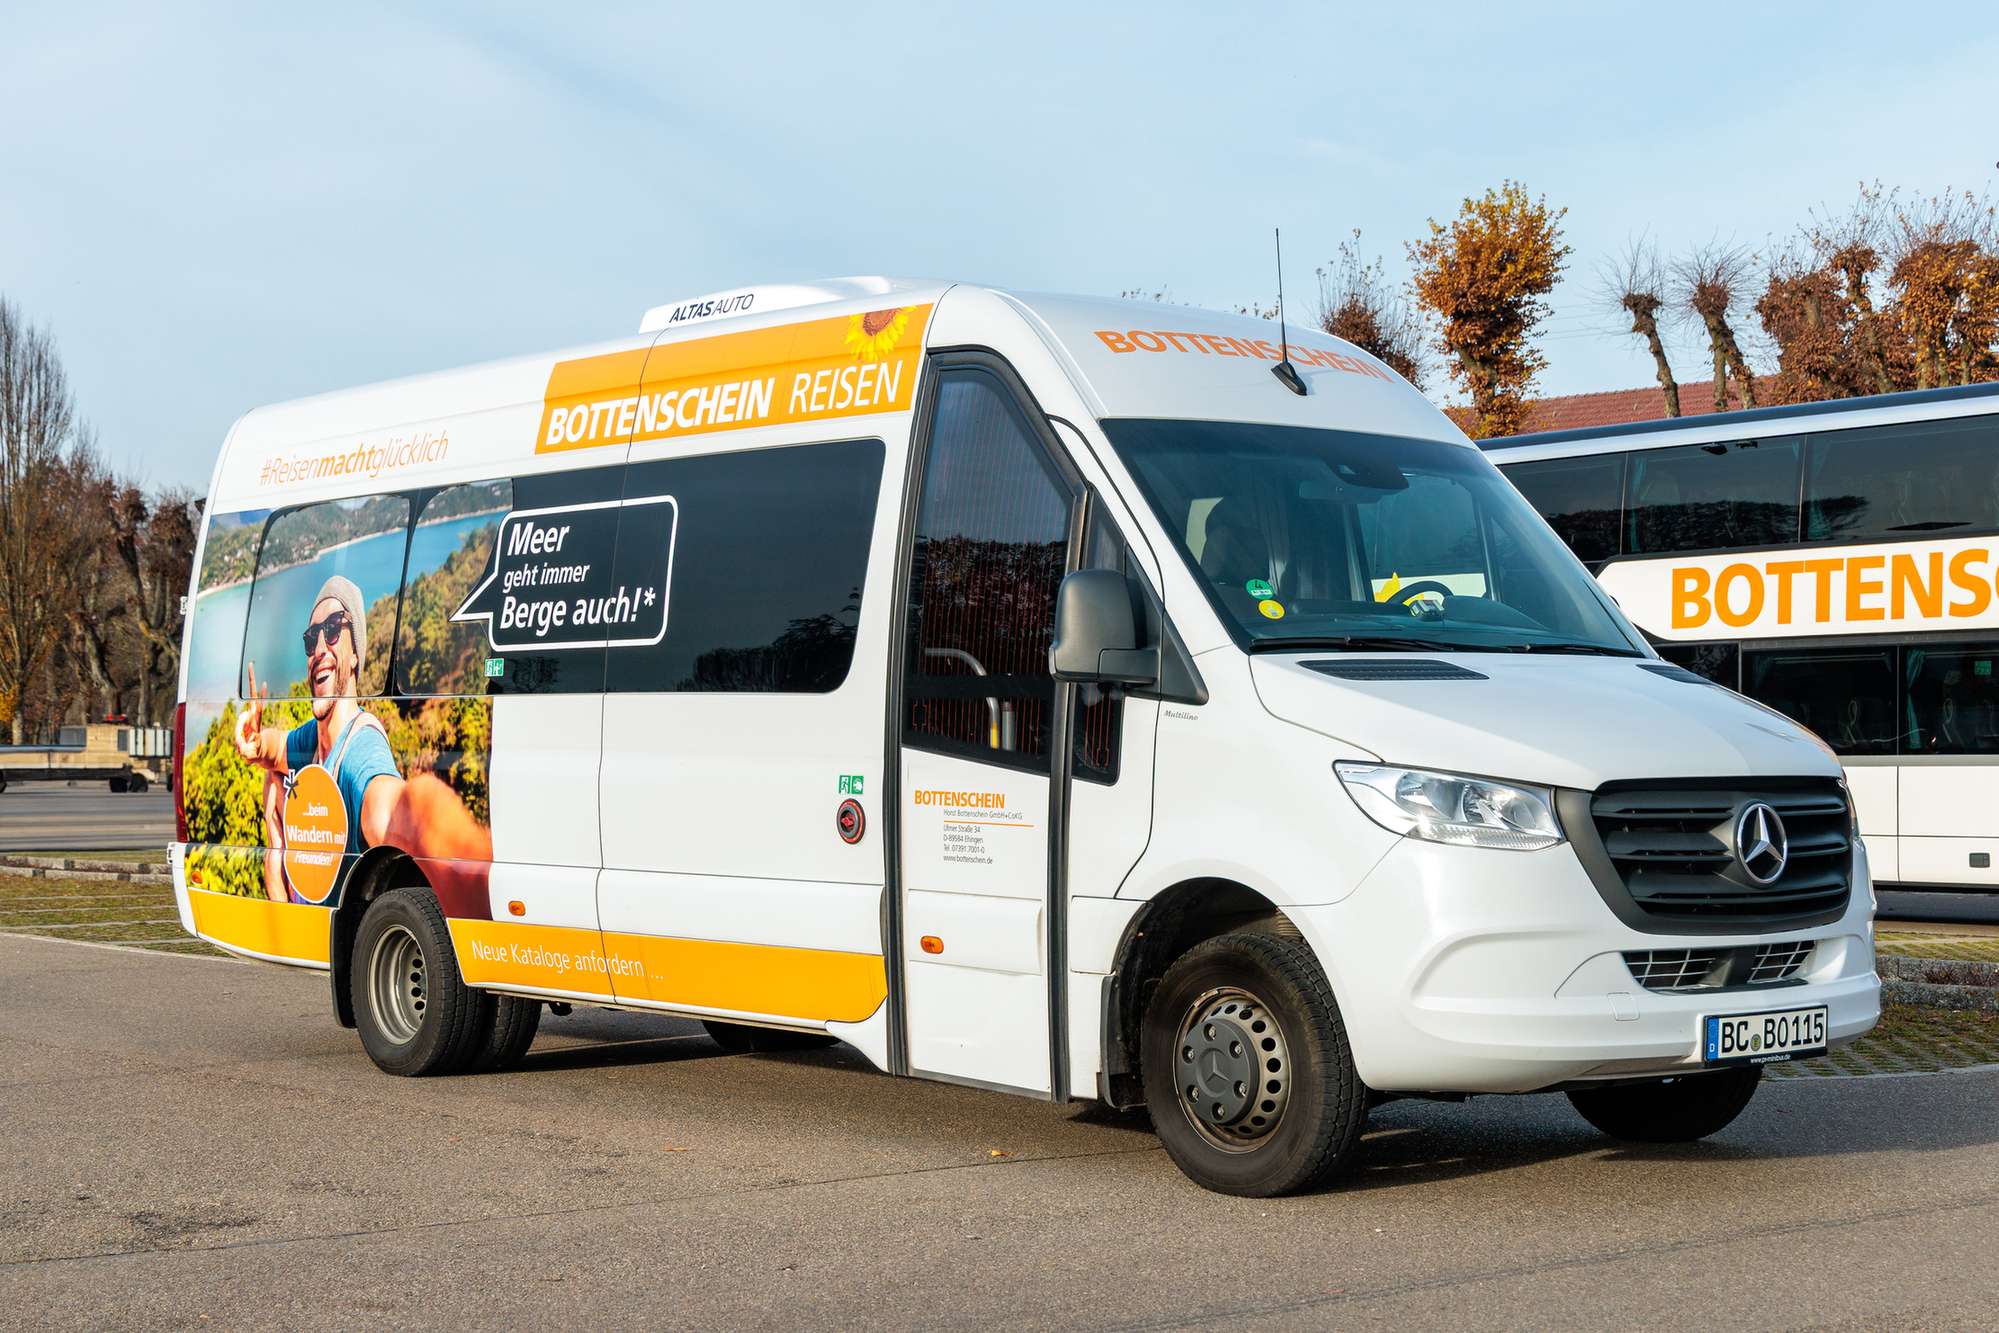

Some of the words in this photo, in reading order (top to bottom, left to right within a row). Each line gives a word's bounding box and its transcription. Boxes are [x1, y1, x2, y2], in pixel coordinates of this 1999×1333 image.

[1093, 330, 1396, 384] BOTTENSCHEIN
[546, 378, 775, 445] BOTTENSCHEIN
[788, 360, 904, 415] REISEN
[507, 521, 571, 556] Meer
[502, 563, 538, 593] geht
[540, 562, 590, 585] immer
[1671, 548, 1999, 630] BOTTENS
[500, 596, 566, 637] Berge
[1164, 710, 1199, 721] Multiline
[914, 790, 1005, 809] BOTTENSCHEIN
[286, 825, 333, 844] Wandern
[471, 940, 508, 963] Neue
[510, 942, 570, 975] Kataloge
[575, 948, 645, 977] anfordern
[1721, 1020, 1749, 1053] BC
